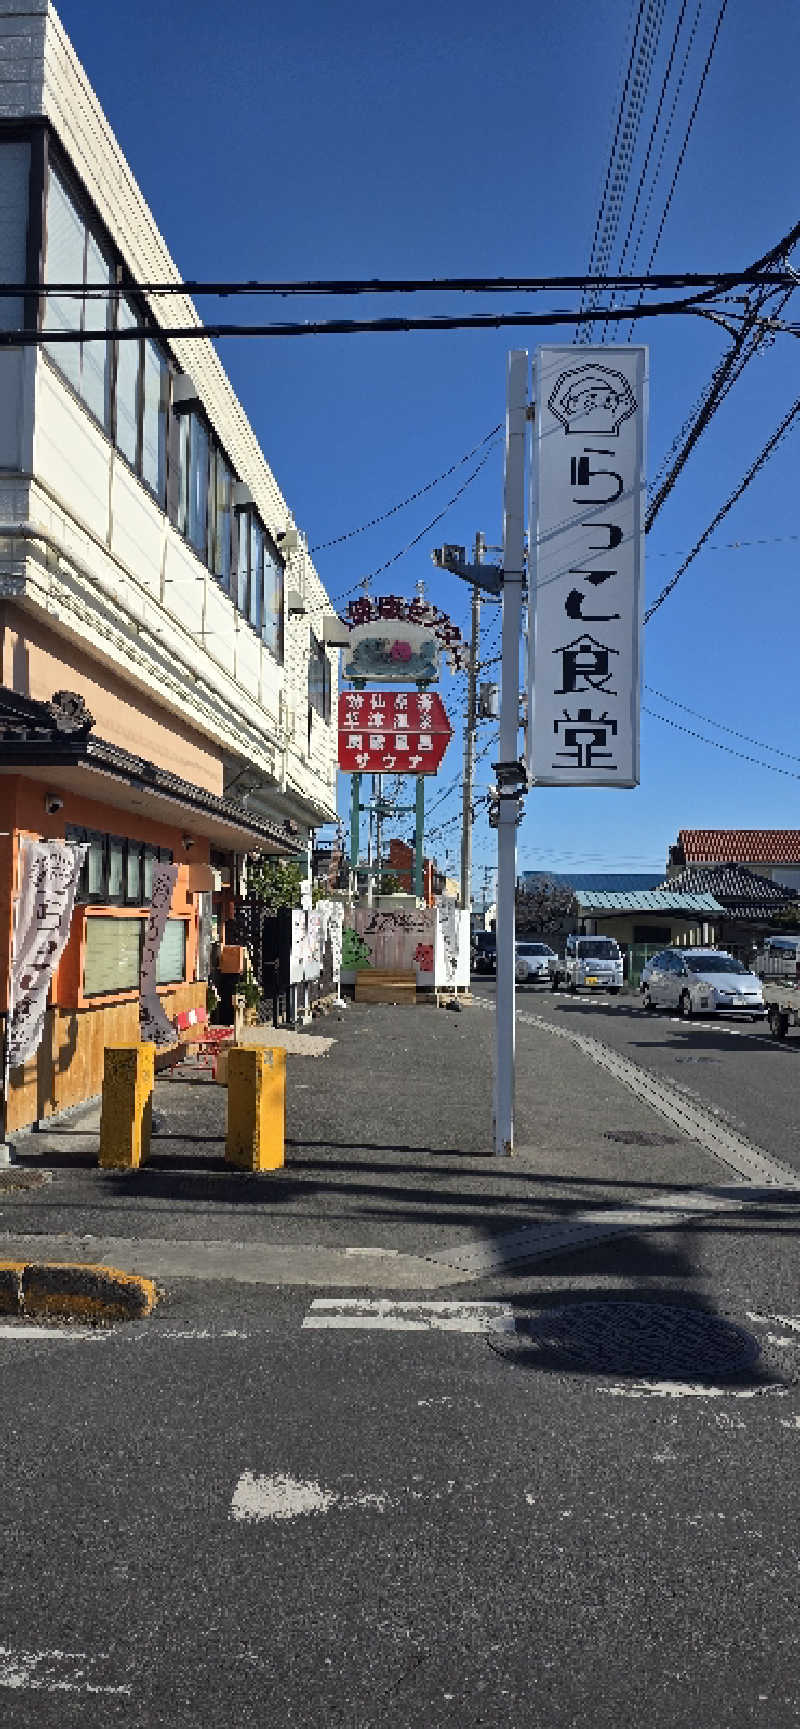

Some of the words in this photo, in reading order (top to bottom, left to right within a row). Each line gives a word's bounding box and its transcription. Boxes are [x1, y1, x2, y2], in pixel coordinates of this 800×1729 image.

[552, 447, 624, 769] らっこ食堂
[354, 752, 424, 770] サウナ
